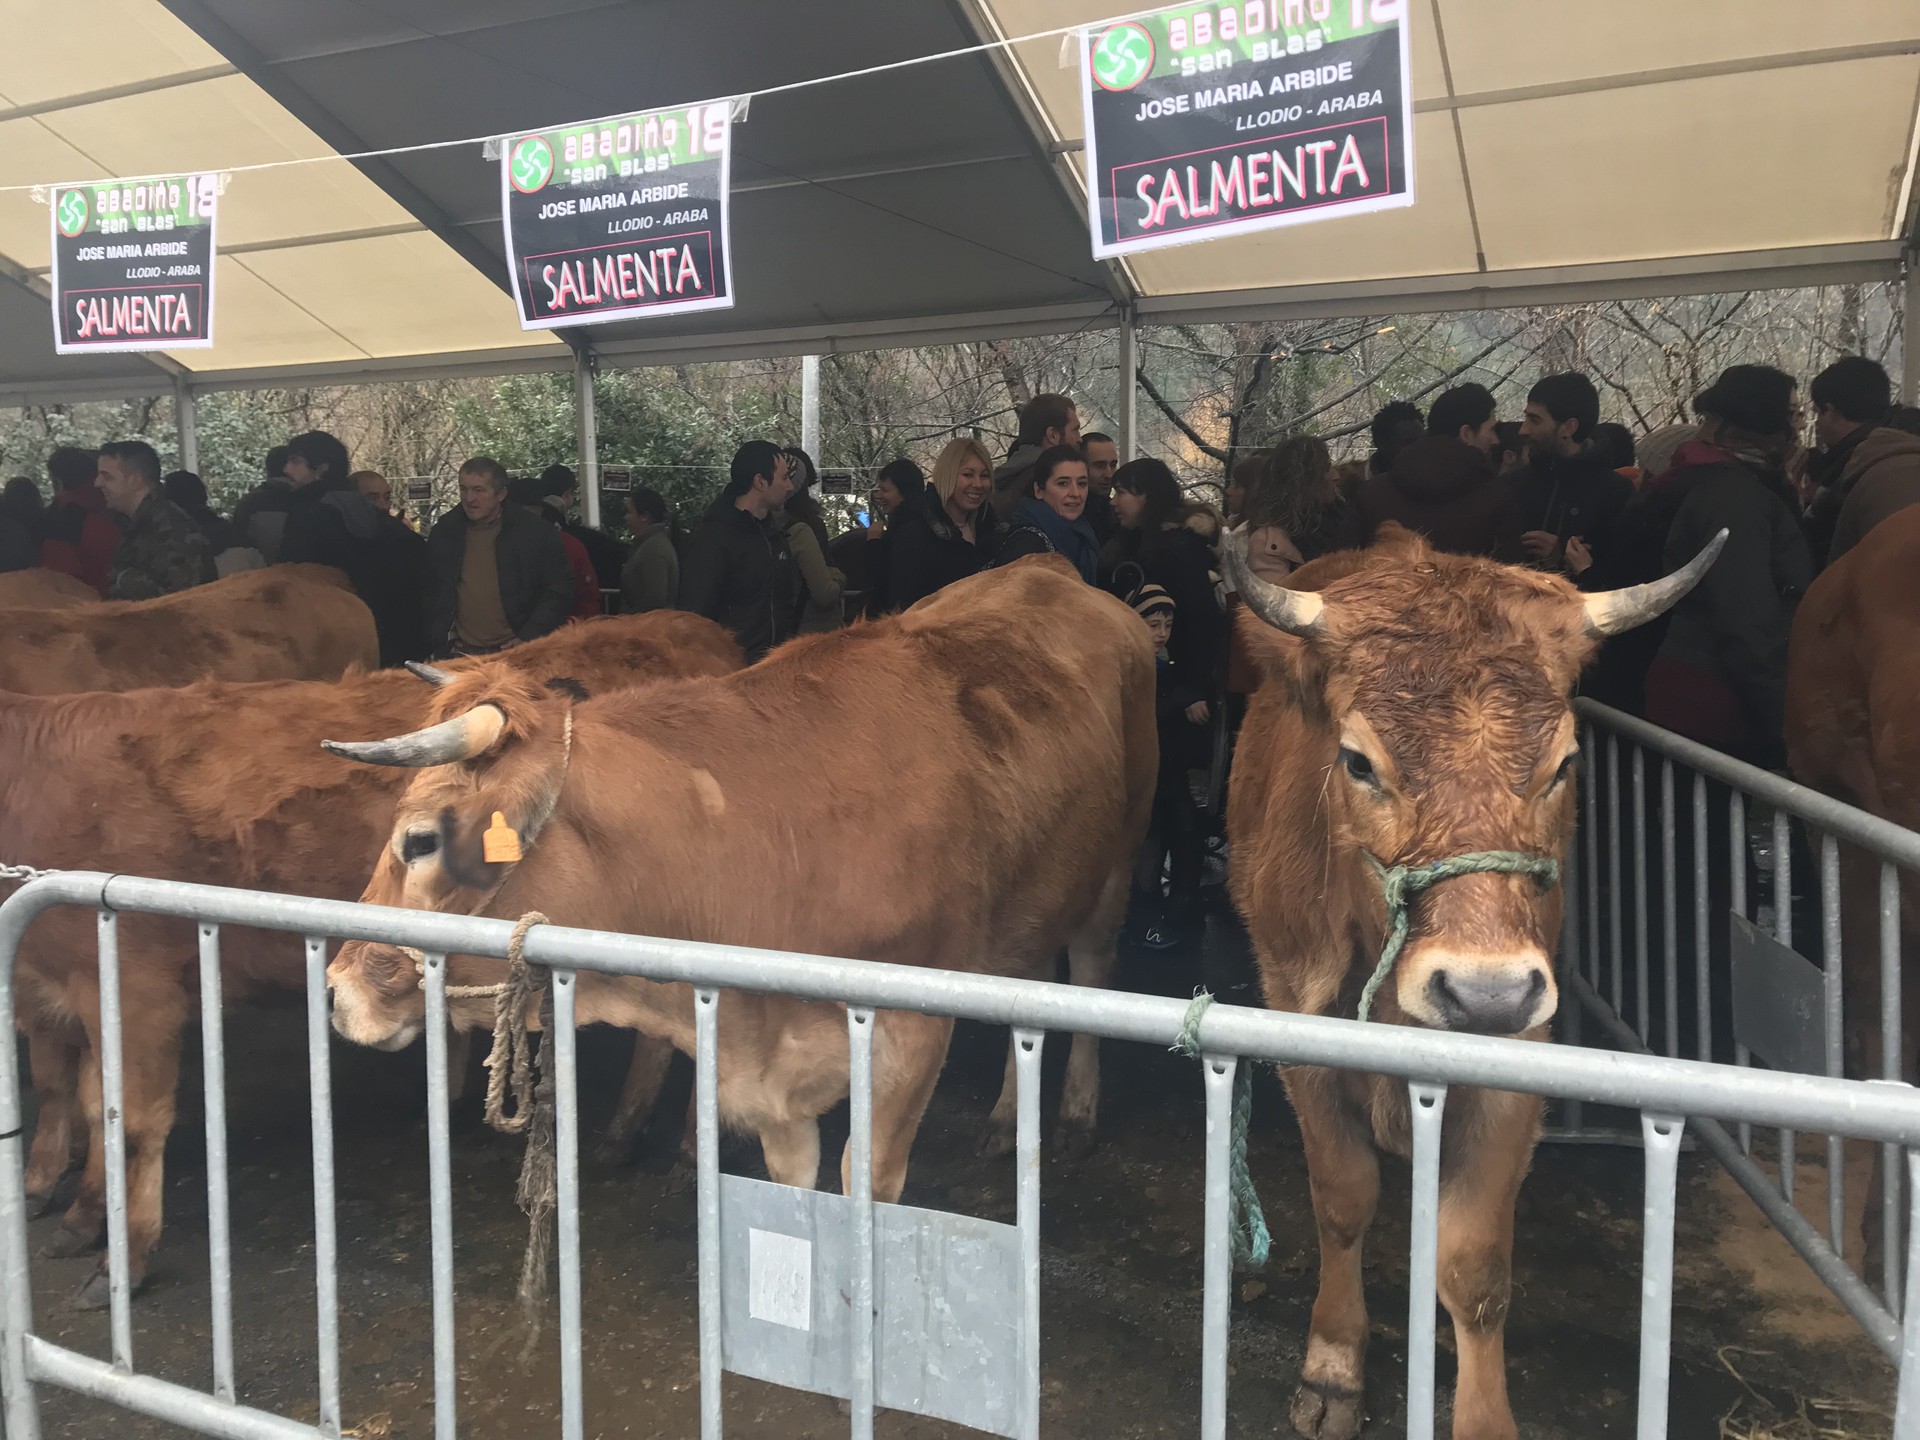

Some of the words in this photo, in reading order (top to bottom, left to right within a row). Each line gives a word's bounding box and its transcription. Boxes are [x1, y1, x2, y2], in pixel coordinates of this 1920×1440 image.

[1135, 94, 1190, 122] JOSE
[1195, 80, 1264, 110] MARIA
[1268, 61, 1353, 95] ARBIDE
[1235, 104, 1302, 131] LLODIO
[1316, 89, 1383, 116] ARABA
[686, 106, 725, 157] 18
[538, 201, 577, 220] JOSE
[579, 193, 627, 213] MARIA
[630, 183, 689, 207] ARBIDE
[1136, 134, 1370, 229] SALMENTA
[607, 215, 654, 234] LLODIO
[662, 208, 709, 227] ARABA
[76, 246, 105, 261] JOSE
[107, 244, 142, 260] MARIA
[144, 241, 188, 257] ARBIDE
[126, 266, 161, 279] LLODIO
[167, 264, 201, 277] ARABA
[542, 243, 702, 310] SALMENTA
[76, 292, 192, 338] SALMENTA
